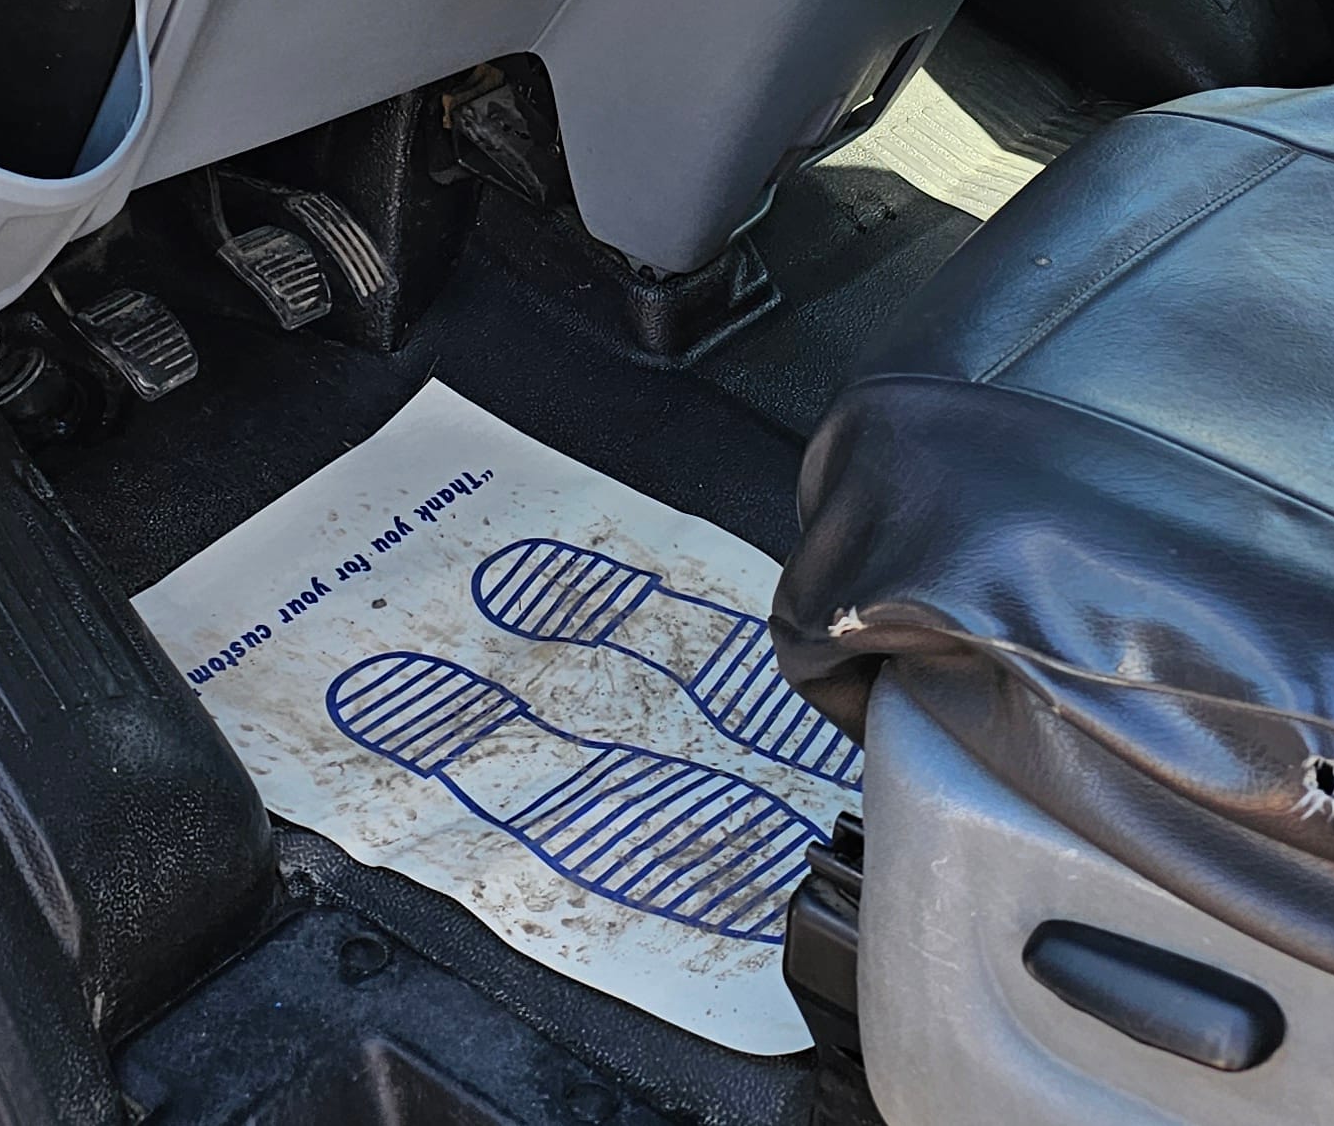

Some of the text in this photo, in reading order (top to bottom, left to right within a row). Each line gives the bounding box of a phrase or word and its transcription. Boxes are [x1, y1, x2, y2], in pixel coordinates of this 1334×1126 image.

[370, 515, 414, 553] you
[334, 553, 372, 582] for
[277, 576, 332, 624] your
